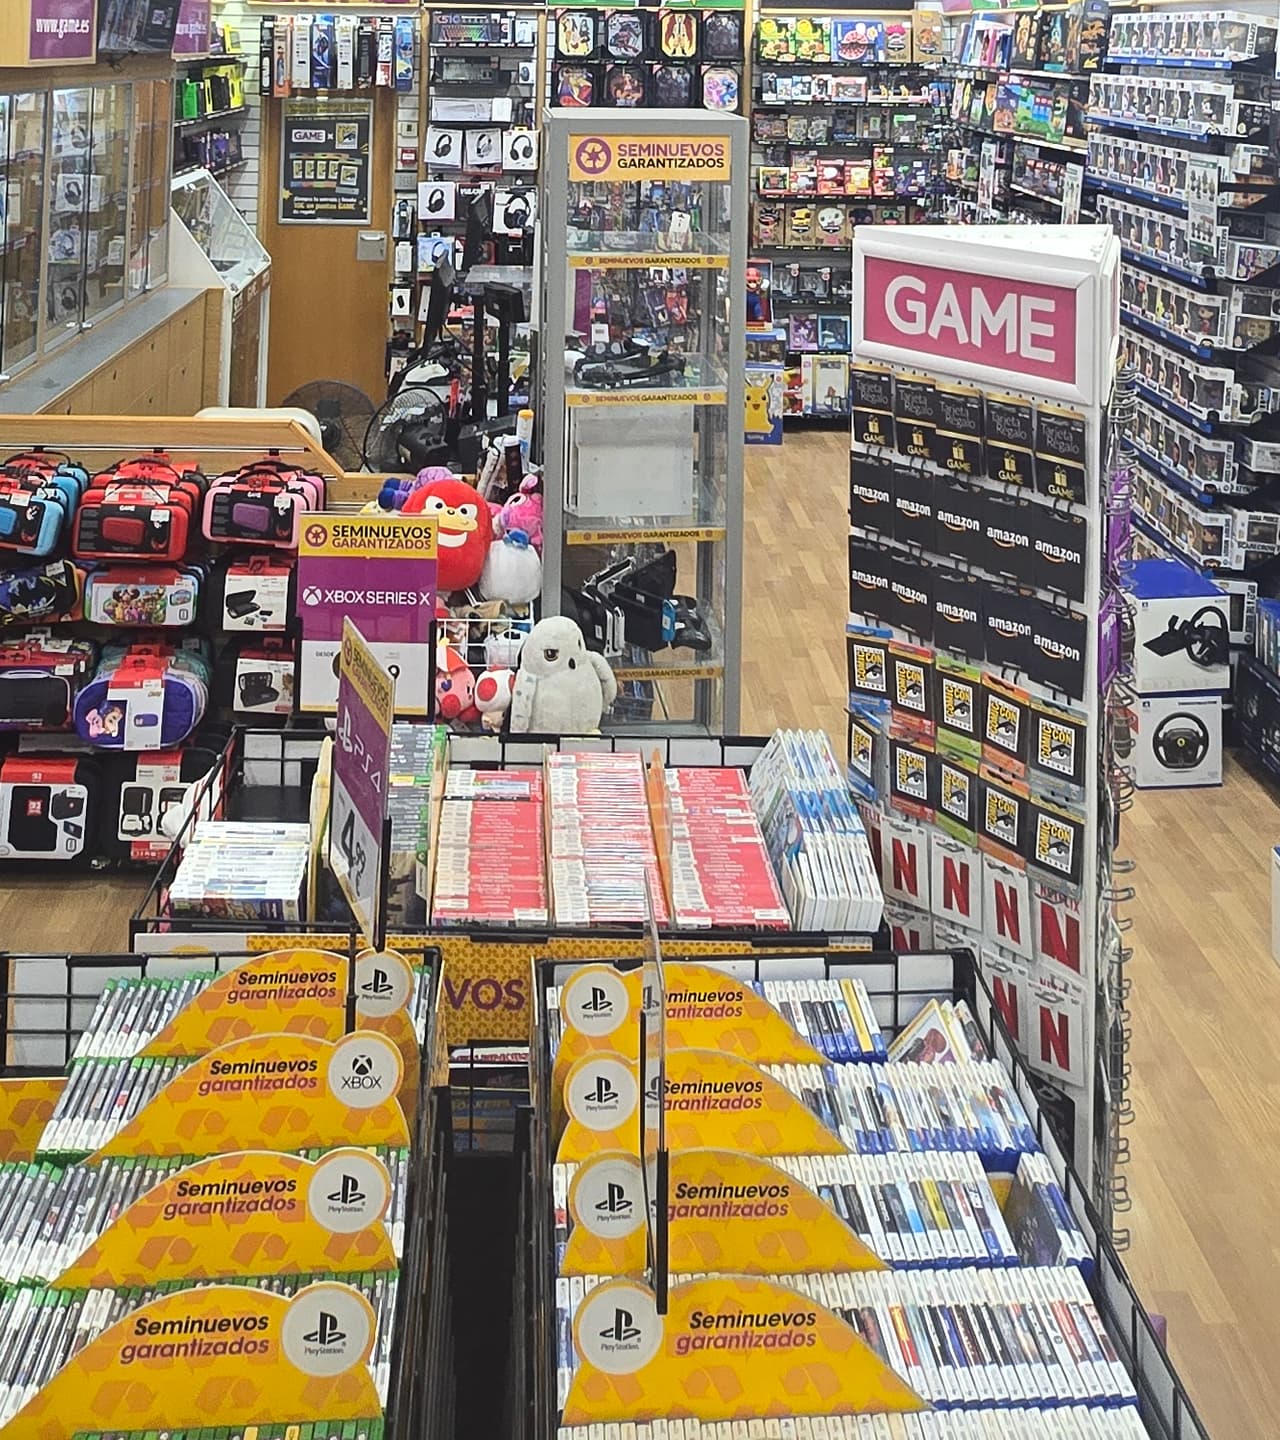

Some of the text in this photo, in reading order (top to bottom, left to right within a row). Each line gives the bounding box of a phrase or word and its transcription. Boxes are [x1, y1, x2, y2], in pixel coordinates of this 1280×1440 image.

[35, 17, 90, 39] www.game.es
[293, 130, 324, 141] GAME
[616, 143, 725, 157] SEMINUEVOS
[616, 157, 725, 169] GARANTIZADOS
[645, 257, 701, 265] GARANTIZADOS
[885, 275, 1055, 363] GAME
[641, 394, 698, 402] GARANTIZADOS
[1041, 423, 1074, 441] Tarjeta
[1046, 435, 1080, 455] Regalo
[853, 484, 890, 503] amazon
[1048, 484, 1074, 499] GAME
[896, 498, 931, 516] amazon
[938, 509, 980, 531] amazon
[332, 525, 432, 539] SEMINUEVOS
[643, 530, 700, 539] GARANTIZADOS
[987, 525, 1029, 547] amazon
[332, 538, 432, 550] GARANTIZADOS
[1035, 539, 1081, 563] amazon
[852, 569, 888, 588] amazon
[324, 589, 431, 606] XBOX SERIES X
[865, 651, 883, 664] CON
[1041, 719, 1073, 759] COMIC CON
[238, 969, 337, 985] Seminuevos
[227, 984, 337, 1003] garantizados
[361, 992, 394, 1000] PlayStation
[663, 989, 743, 1003] eminuevos
[209, 1057, 318, 1076] Seminuevos
[198, 1073, 318, 1096] garantizados
[341, 1076, 382, 1090] XBOX
[662, 1079, 763, 1095] Seminuevos
[586, 1104, 618, 1112] PlayStation
[663, 1094, 763, 1110] arantizados
[176, 1177, 297, 1198] Seminuevos
[675, 1183, 789, 1199] Seminuevos
[163, 1196, 297, 1221] garantizados
[328, 1205, 364, 1214] PlayStation
[666, 1202, 788, 1220] garantizados
[134, 1313, 269, 1336] Seminuevos
[689, 1310, 816, 1329] Seminuevos
[120, 1337, 269, 1364] garantizados
[304, 1346, 345, 1356] PlayStation
[600, 1342, 640, 1352] PlayStation
[675, 1330, 816, 1356] garantizados
